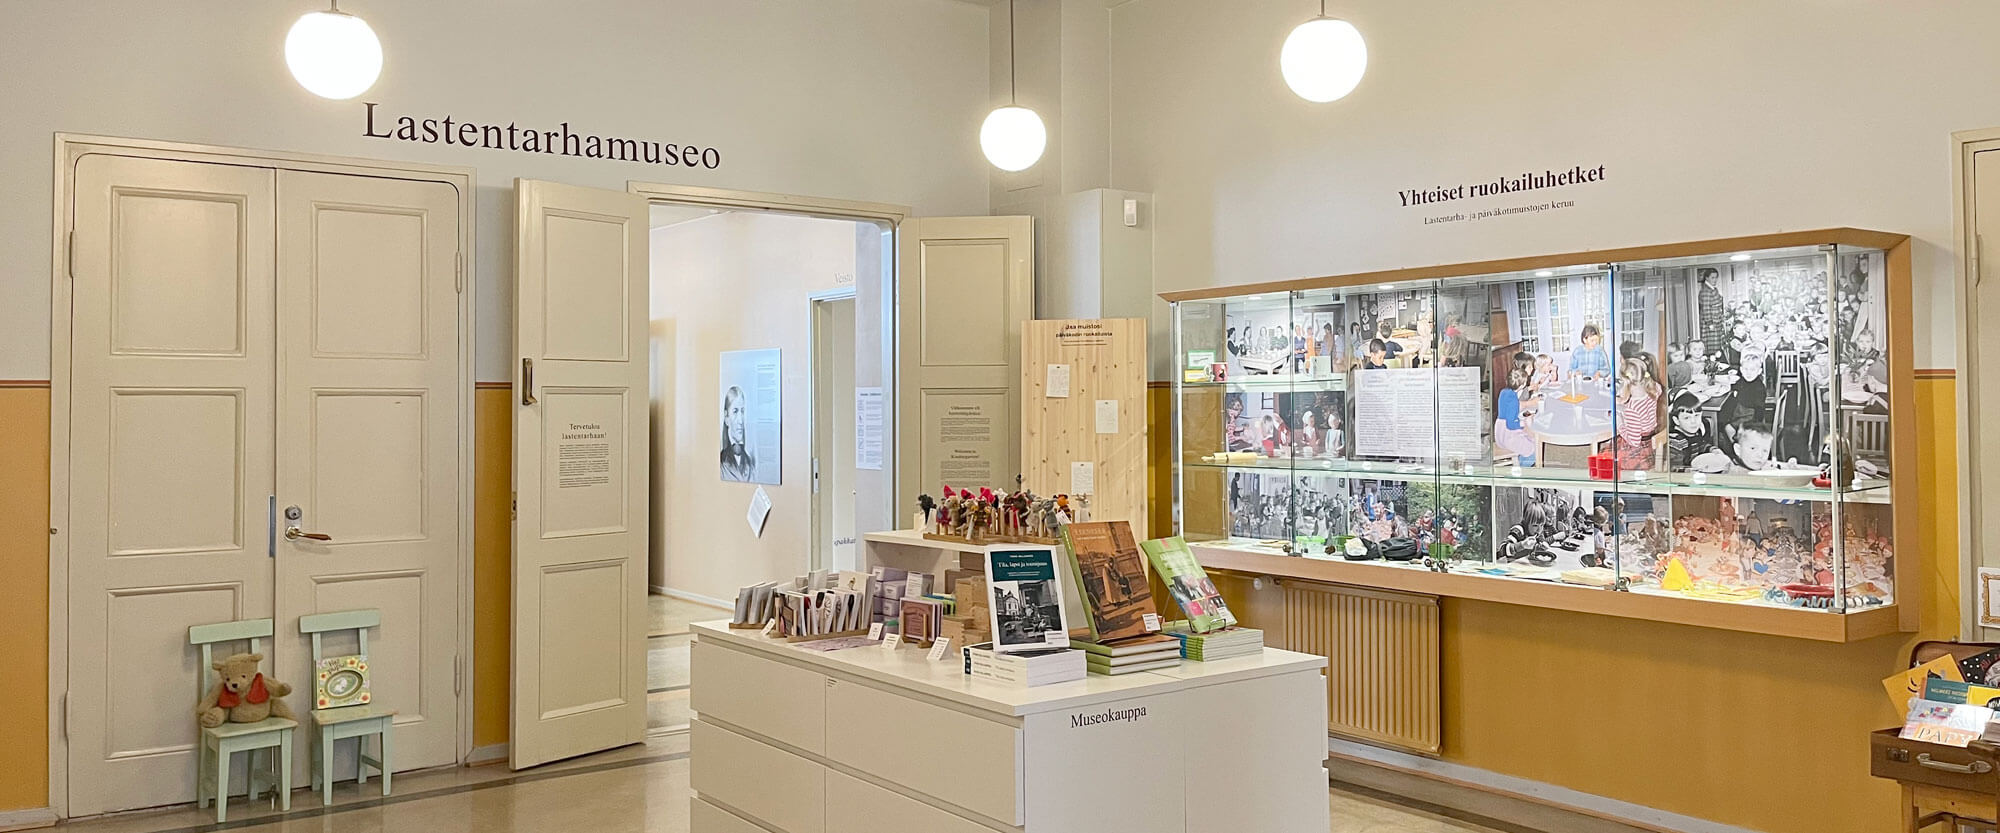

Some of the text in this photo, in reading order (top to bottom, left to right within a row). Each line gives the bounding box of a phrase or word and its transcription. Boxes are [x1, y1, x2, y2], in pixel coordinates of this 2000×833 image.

[362, 102, 721, 169] Lastentarhamuseo
[1398, 164, 1605, 207] Yhteiset ruokailuhetket
[1424, 200, 1575, 225] Lastentarha- ja päiväkotimuistojen keruu
[561, 432, 607, 440] lastentarhaan!
[1071, 706, 1147, 729] Museokauppa
